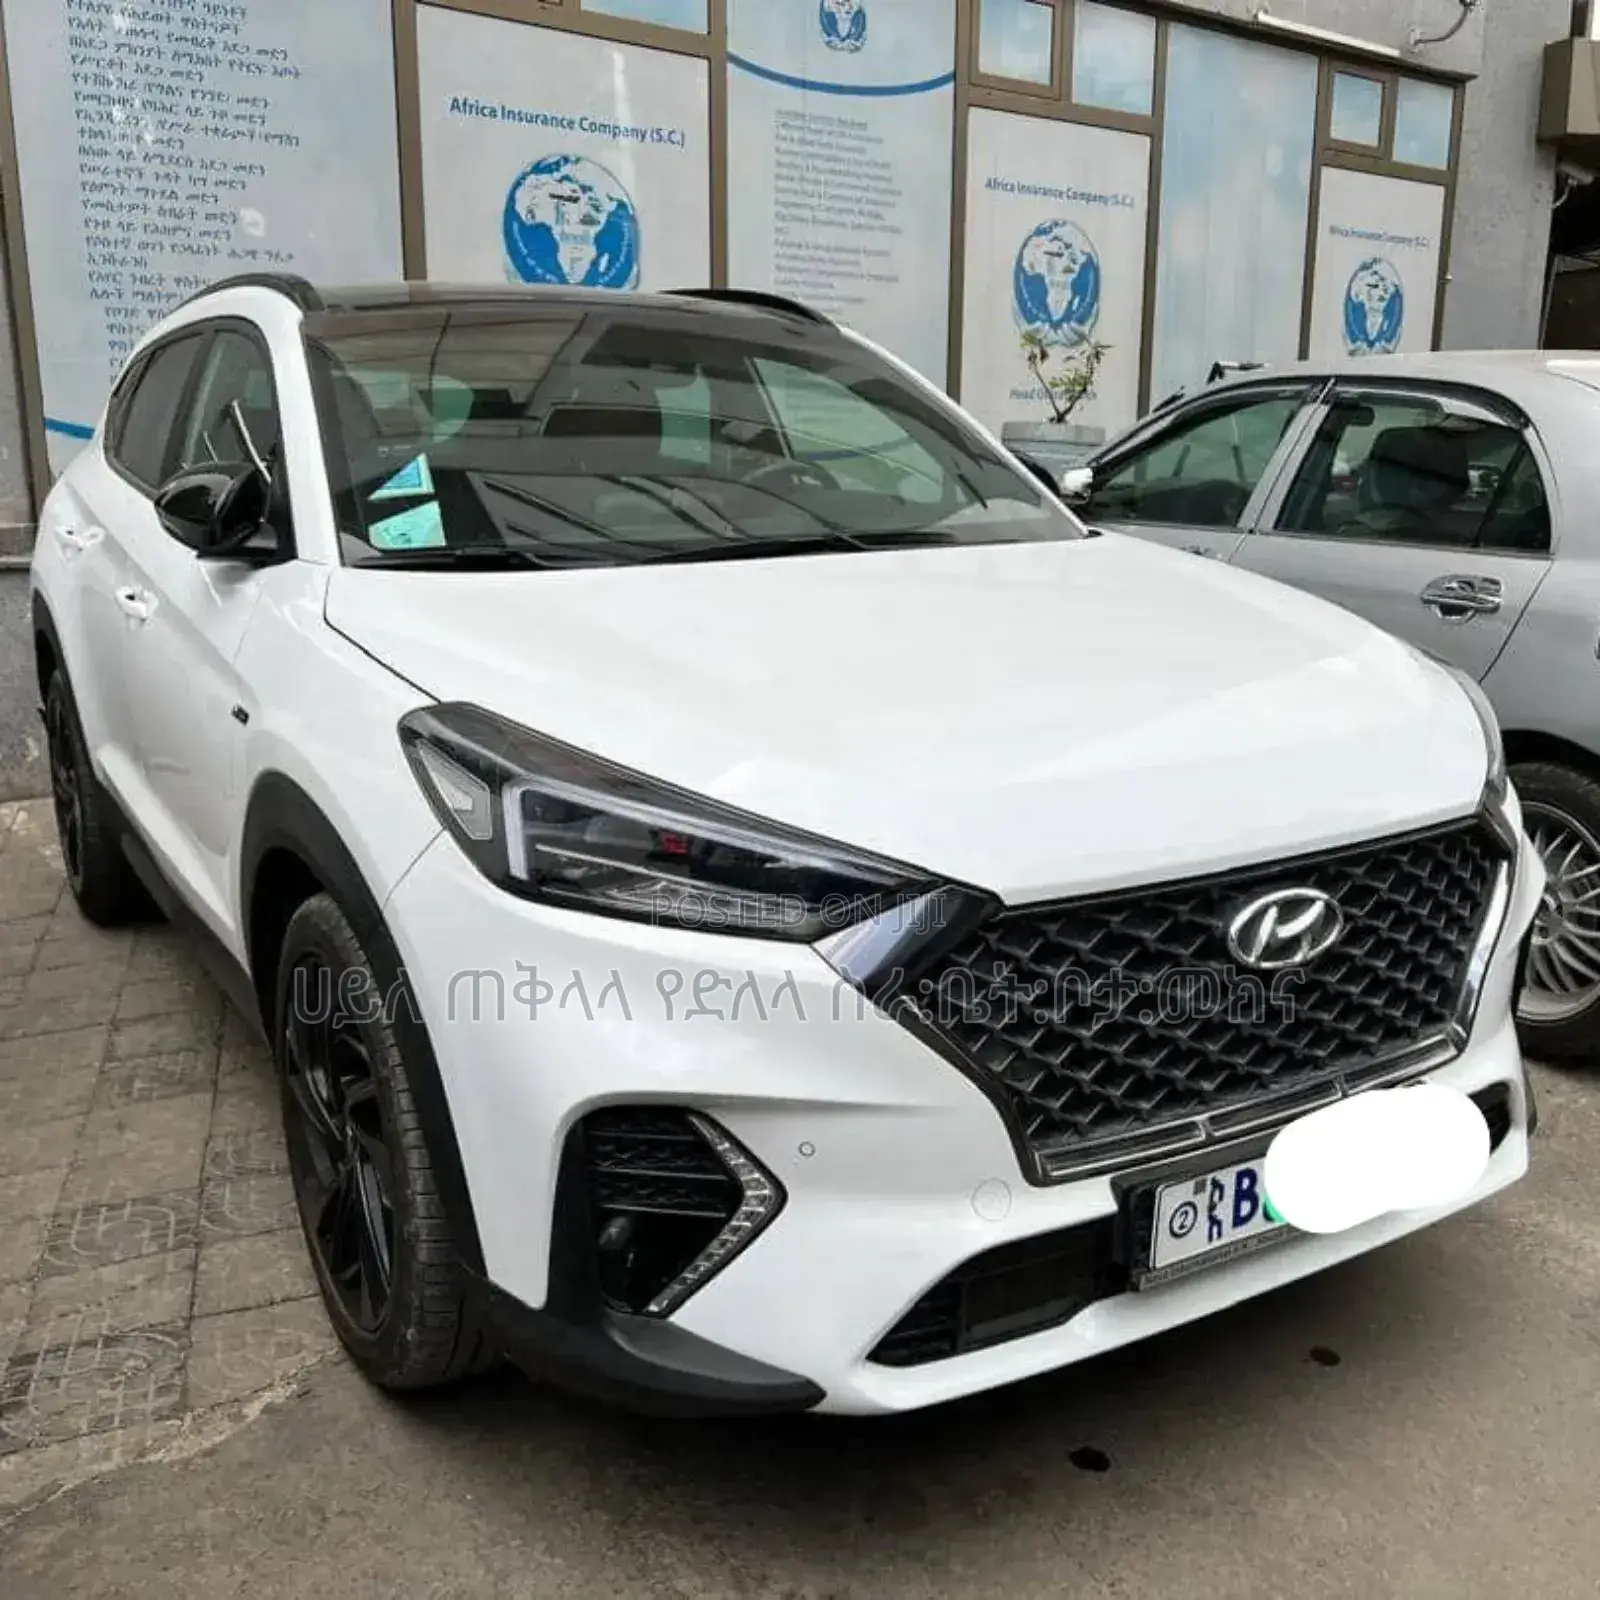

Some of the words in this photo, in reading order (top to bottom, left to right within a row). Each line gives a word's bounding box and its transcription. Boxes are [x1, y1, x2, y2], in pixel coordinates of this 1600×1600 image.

[449, 96, 498, 120] Africa
[500, 103, 576, 131] Insurance
[578, 116, 647, 144] Company
[650, 127, 686, 149] (S.C.)
[985, 175, 1015, 193] Africa
[1016, 179, 1064, 201] Insurance
